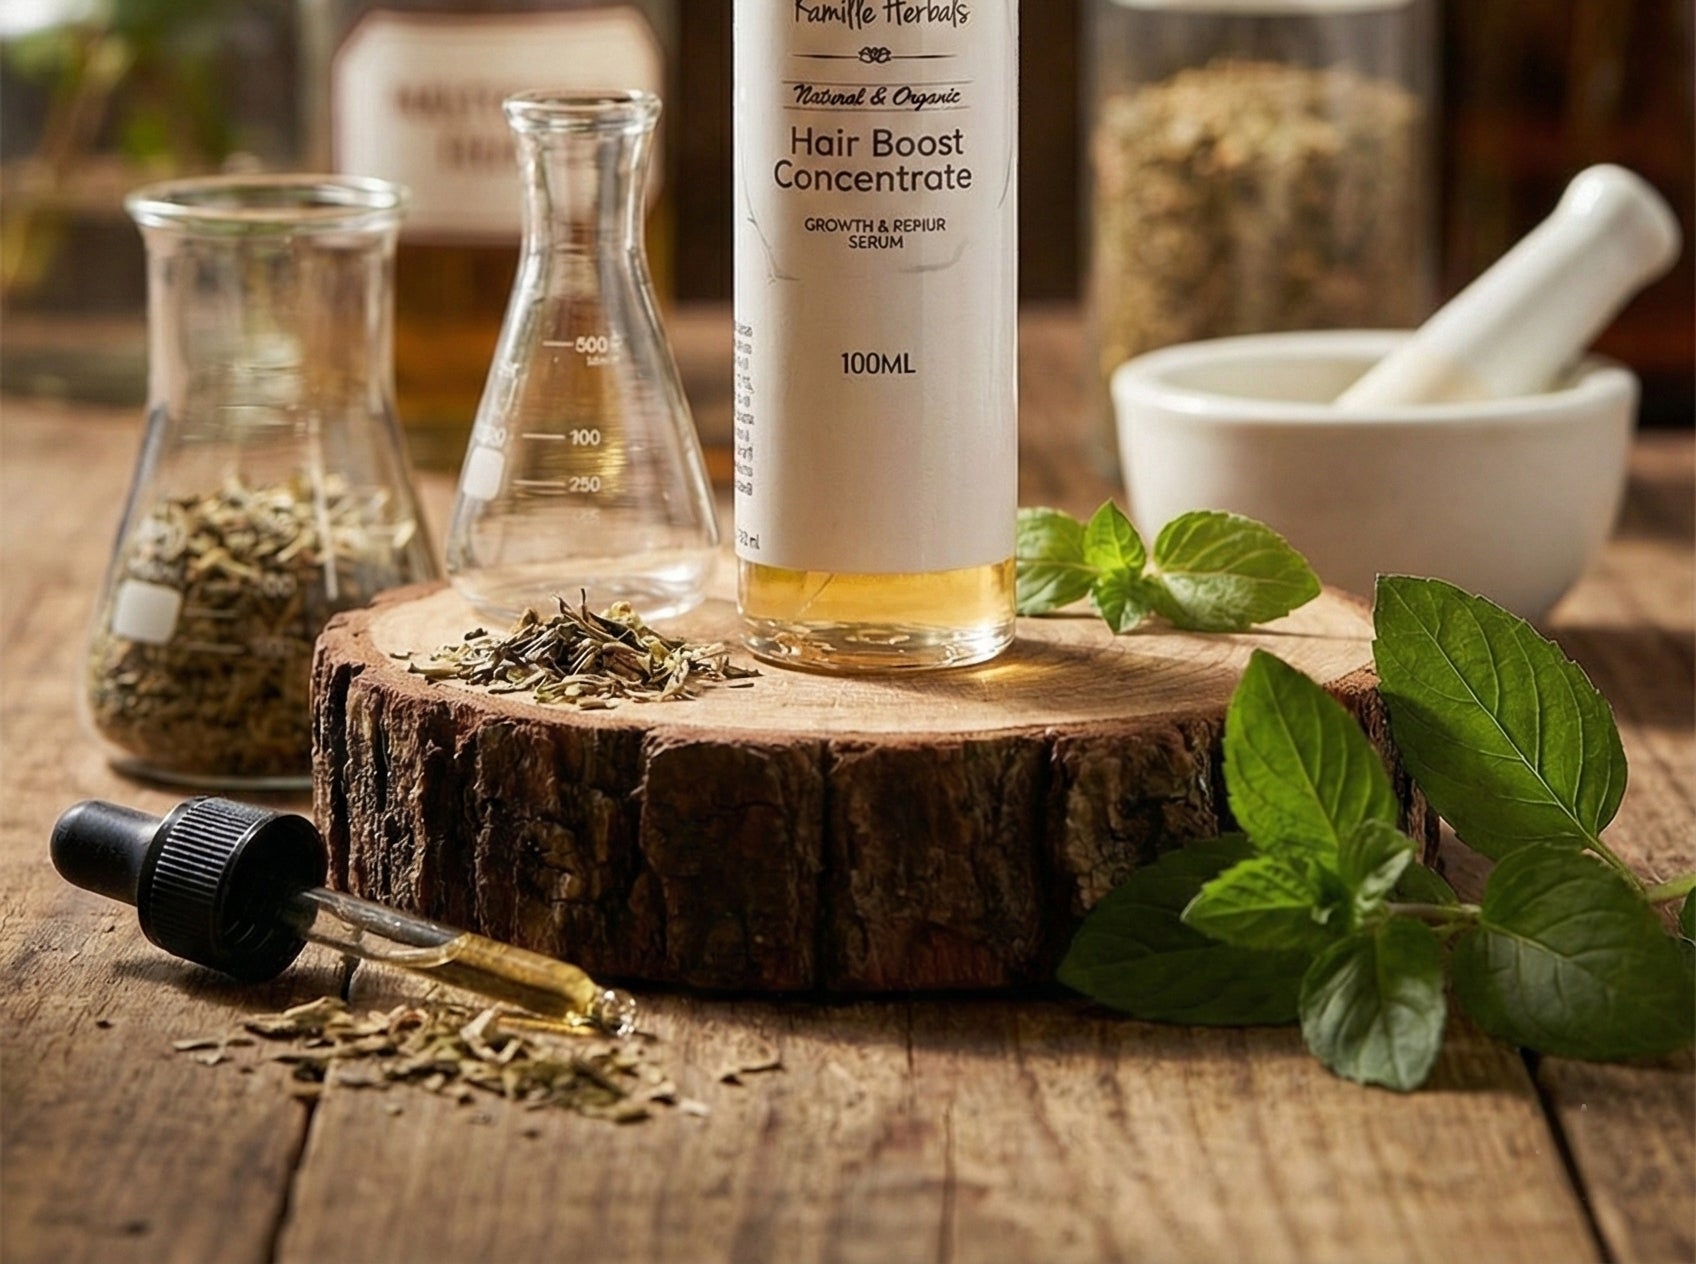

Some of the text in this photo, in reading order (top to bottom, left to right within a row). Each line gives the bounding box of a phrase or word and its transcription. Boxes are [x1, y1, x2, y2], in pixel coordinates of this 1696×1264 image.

[793, 84, 961, 111] Natural & Organic
[791, 126, 964, 157] Hair Boost
[774, 159, 972, 192] Concentrate
[804, 217, 874, 233] GROWTH
[878, 220, 889, 233] &
[848, 235, 904, 249] SERUM
[841, 352, 916, 374] 100ML
[569, 429, 601, 446] 100
[569, 476, 601, 492] 250
